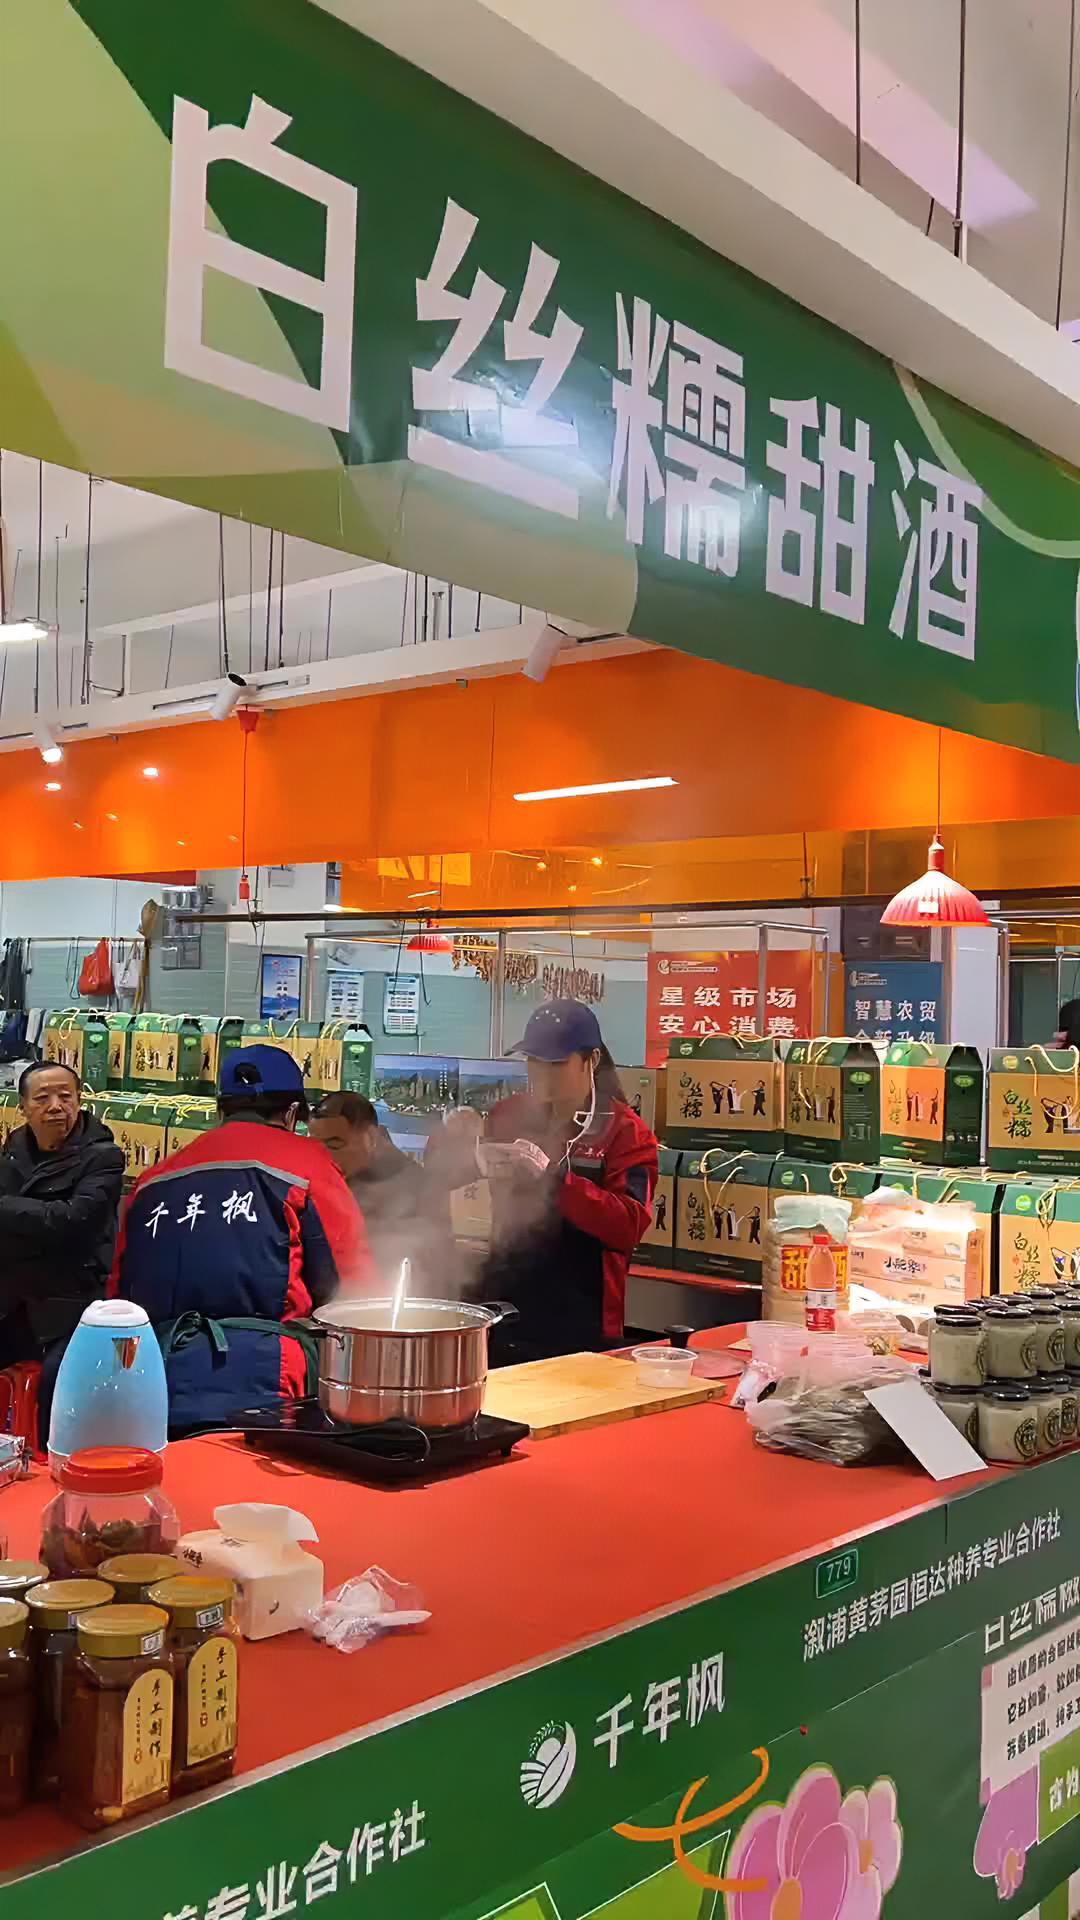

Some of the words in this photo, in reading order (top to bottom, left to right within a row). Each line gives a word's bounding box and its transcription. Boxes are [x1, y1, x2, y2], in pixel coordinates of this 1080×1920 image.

[164, 93, 984, 662] 白丝糯甜酒
[659, 985, 797, 1009] 星级市场
[855, 999, 937, 1022] 智慧农贸
[659, 1014, 797, 1039] 安心消费
[1003, 1088, 1033, 1140] 白丝糯
[145, 1190, 258, 1239] 千年枫
[804, 1506, 1061, 1661] 溆浦黄茅园恒达种养专业合作社
[827, 1556, 851, 1583] 779
[594, 1651, 726, 1768] 千年枫
[163, 1799, 426, 1920] 专业合作社
